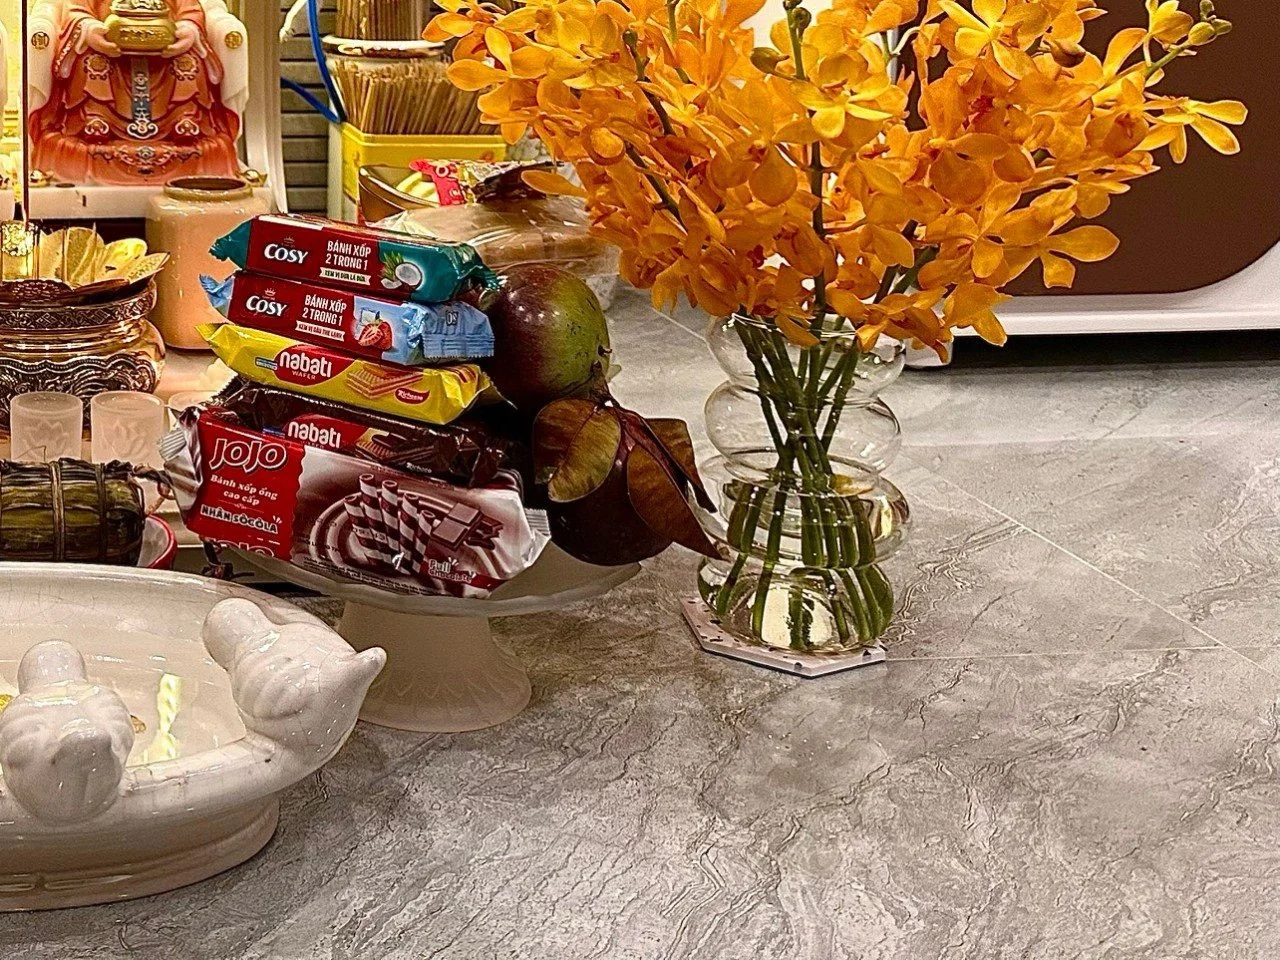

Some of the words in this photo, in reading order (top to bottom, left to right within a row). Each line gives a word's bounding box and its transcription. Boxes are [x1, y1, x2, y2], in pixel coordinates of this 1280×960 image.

[263, 242, 308, 265] COSY
[326, 239, 352, 256] BÁNH
[352, 242, 372, 258] XỐP
[325, 254, 332, 265] 2
[333, 255, 363, 270] TRONG
[363, 259, 368, 271] 1
[245, 295, 288, 317] COSY
[304, 294, 329, 311] BÁNH
[329, 298, 348, 314] XỐP
[302, 307, 308, 318] 2
[309, 309, 337, 325] TRONG
[338, 315, 343, 327] 1
[279, 351, 333, 378] nabati
[291, 370, 317, 381] WAFER
[287, 421, 341, 449] nabati
[208, 438, 287, 473] JOJO
[210, 474, 237, 489] Bánh
[237, 483, 257, 495] xốp
[258, 486, 278, 501] ống
[223, 490, 240, 500] cao
[241, 494, 260, 506] cấp
[200, 504, 232, 523] NHÂN
